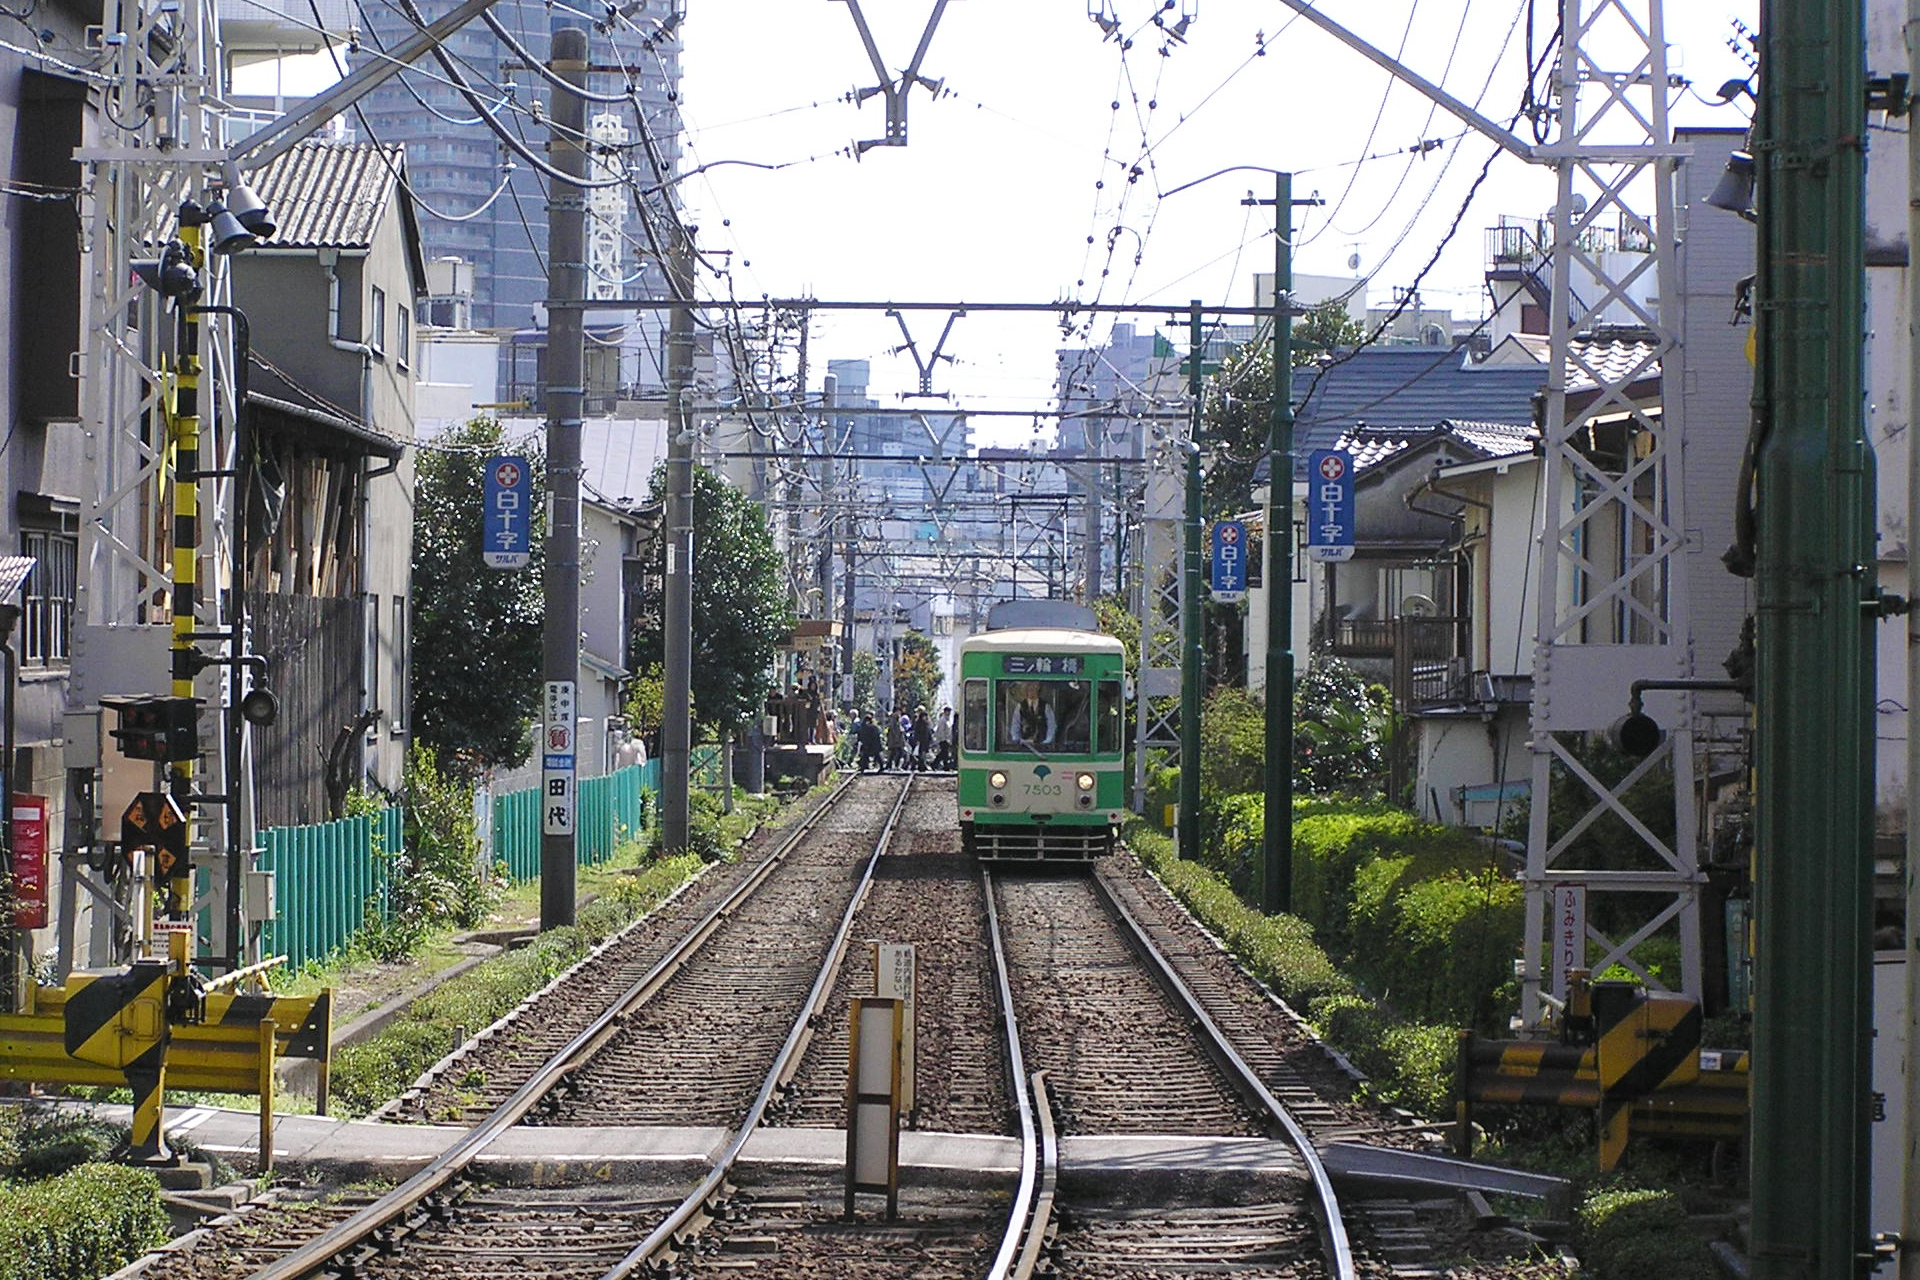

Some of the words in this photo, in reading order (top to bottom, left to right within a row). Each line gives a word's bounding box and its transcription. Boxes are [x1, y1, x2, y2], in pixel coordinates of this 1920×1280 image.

[496, 489, 519, 550] 白十字
[1320, 482, 1343, 543] 白十字
[1220, 545, 1238, 589] 白十字
[1010, 657, 1078, 673] 三ノ輪橋
[548, 779, 567, 827] 田代
[1023, 784, 1062, 796] 7503
